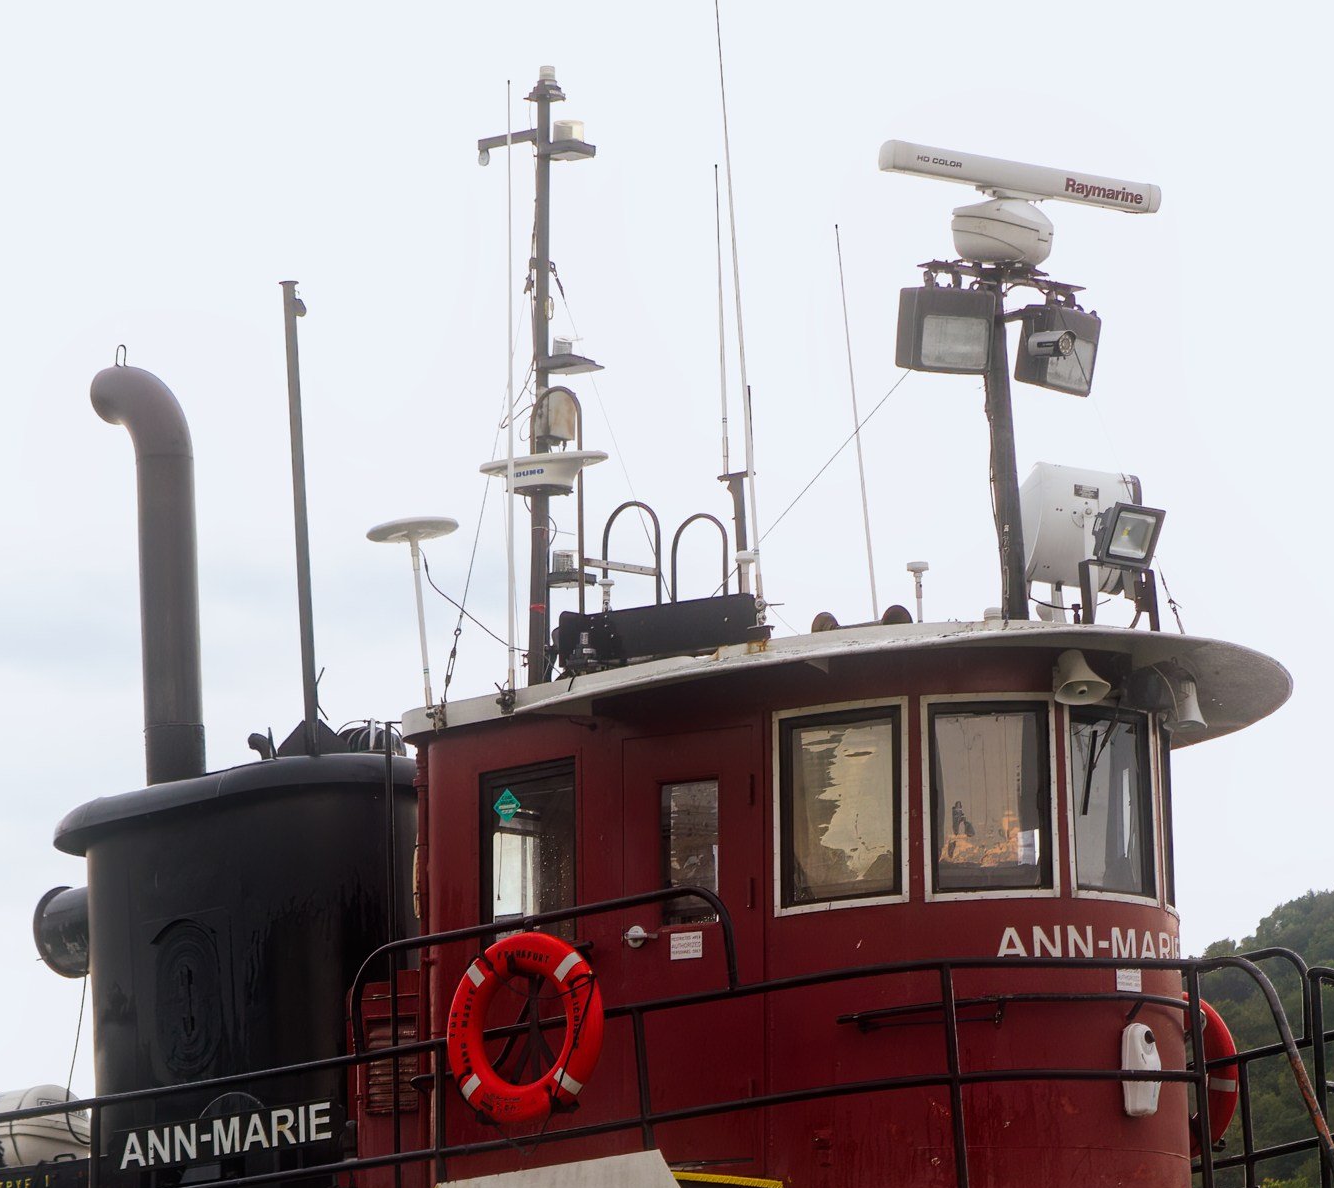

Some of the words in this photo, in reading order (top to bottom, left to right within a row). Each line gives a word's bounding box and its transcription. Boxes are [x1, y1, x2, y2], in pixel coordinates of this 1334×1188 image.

[916, 154, 930, 163] HD
[932, 157, 963, 169] COLOR
[1063, 177, 1144, 206] Raymarine
[120, 1101, 333, 1171] ANN-MARIE
